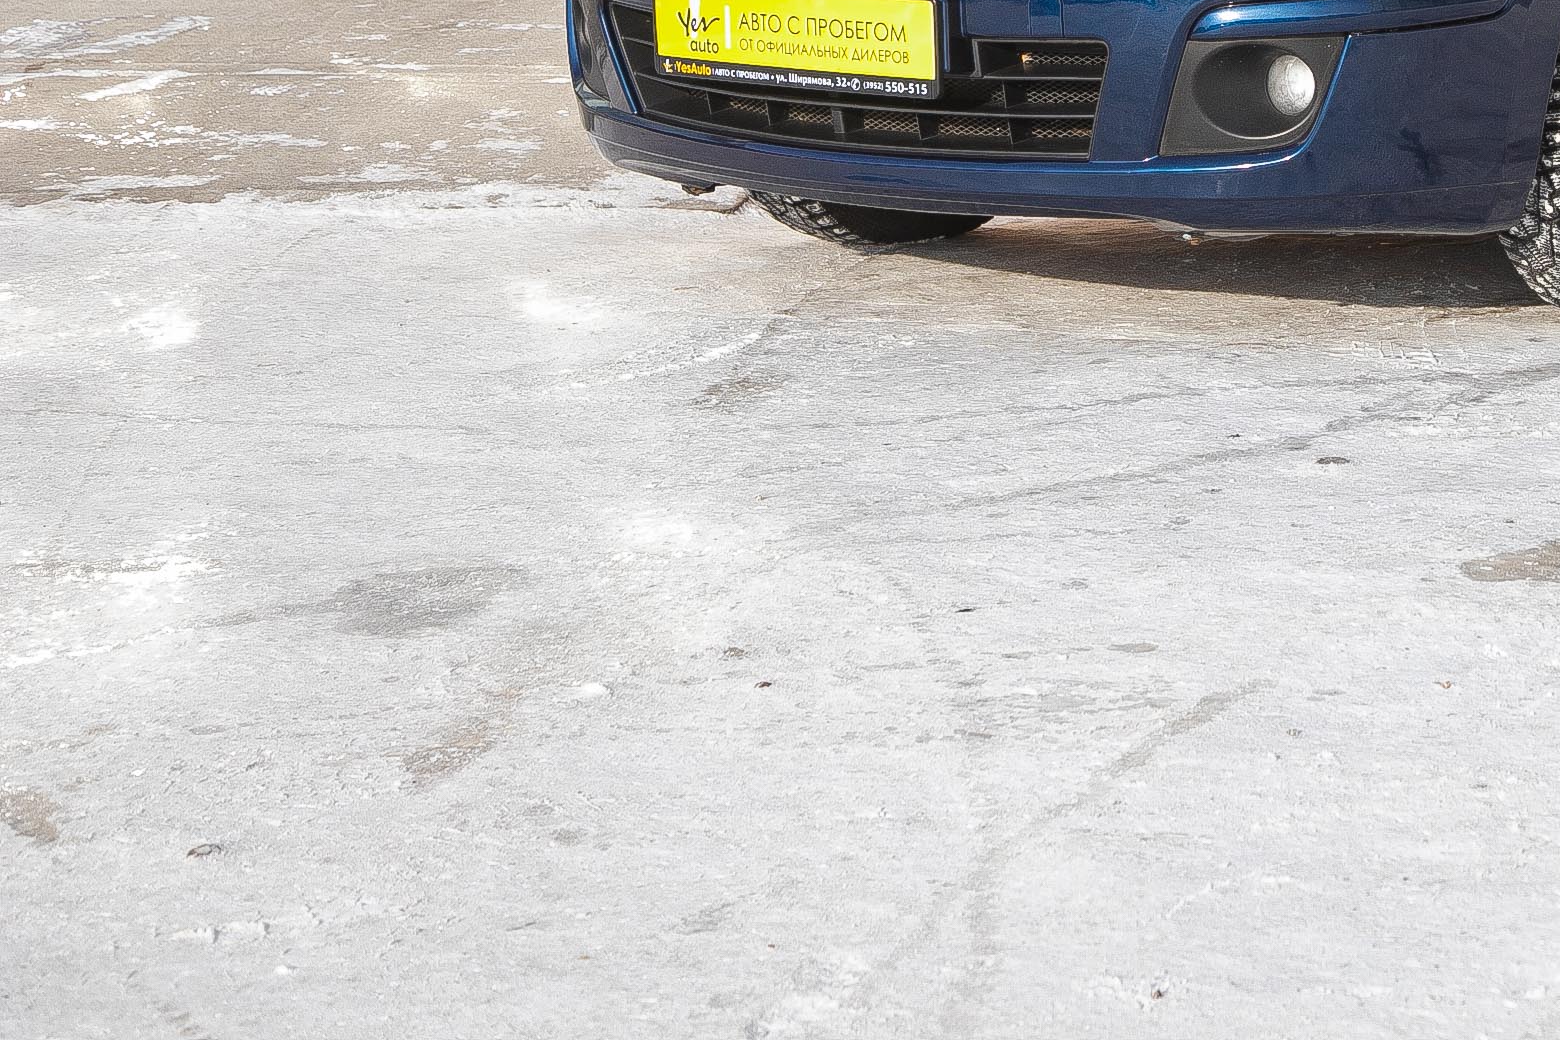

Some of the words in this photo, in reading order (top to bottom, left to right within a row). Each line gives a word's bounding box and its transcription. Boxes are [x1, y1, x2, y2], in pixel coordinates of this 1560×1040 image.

[677, 7, 721, 38] Yes
[738, 12, 782, 34] АВТО
[787, 15, 801, 35] С
[806, 17, 907, 43] ПРОБЕГОМ
[690, 38, 720, 54] auto
[739, 38, 754, 51] ОТ
[756, 39, 849, 60] ОФИЦИАЛЬНЫХ
[851, 48, 910, 64] ДИЛЕРОВ
[775, 73, 788, 84] ул.
[788, 72, 835, 87] Ширямова,
[835, 76, 847, 88] 32
[884, 81, 928, 96] 550-515
